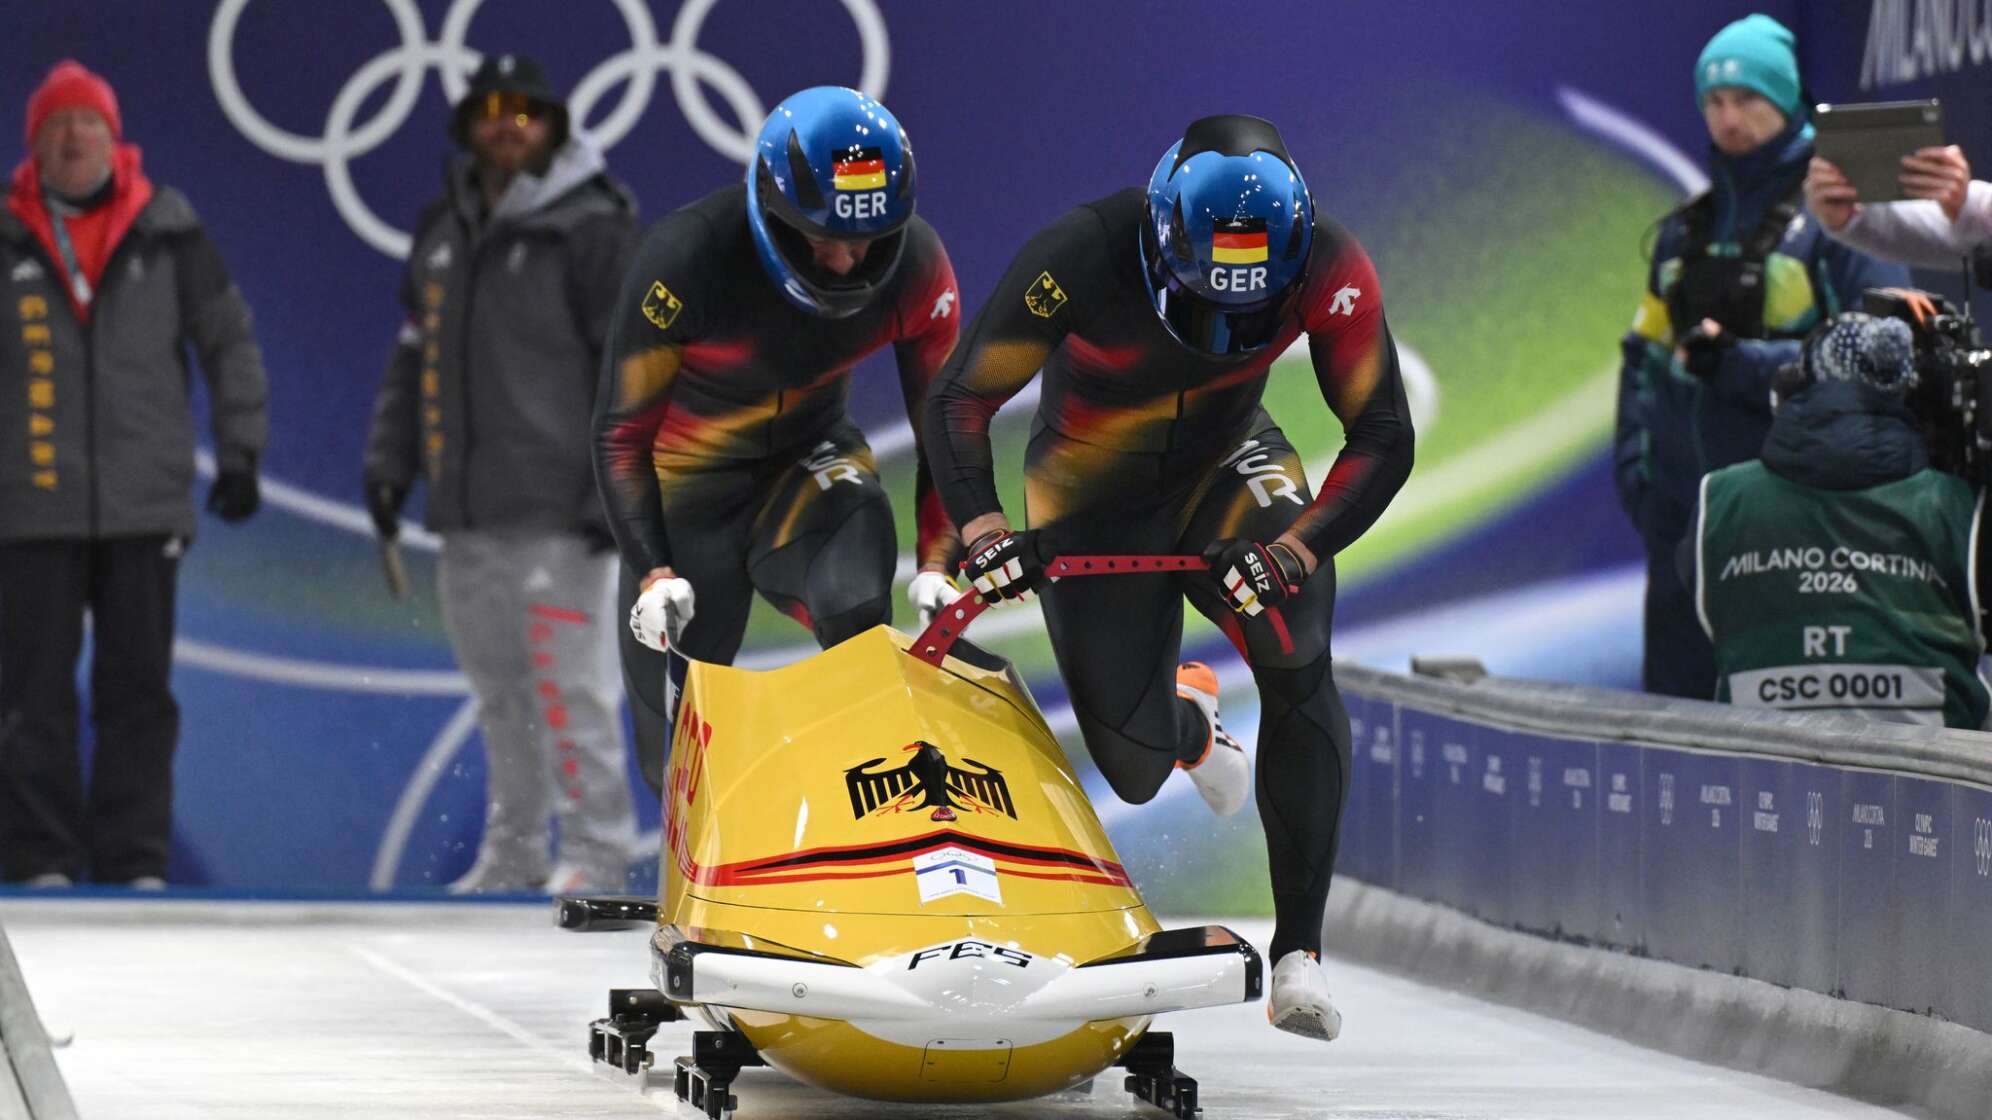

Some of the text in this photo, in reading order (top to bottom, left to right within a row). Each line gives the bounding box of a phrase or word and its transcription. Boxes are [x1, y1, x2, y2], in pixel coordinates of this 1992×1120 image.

[834, 191, 887, 219] GER
[1210, 266, 1268, 292] GER
[1720, 547, 1948, 588] MILANO CORTINA
[1798, 570, 1859, 594] 2026
[1803, 625, 1852, 657] RT
[1758, 672, 1904, 703] CSC 0001
[948, 868, 967, 885] 1
[907, 940, 1033, 970] FES
